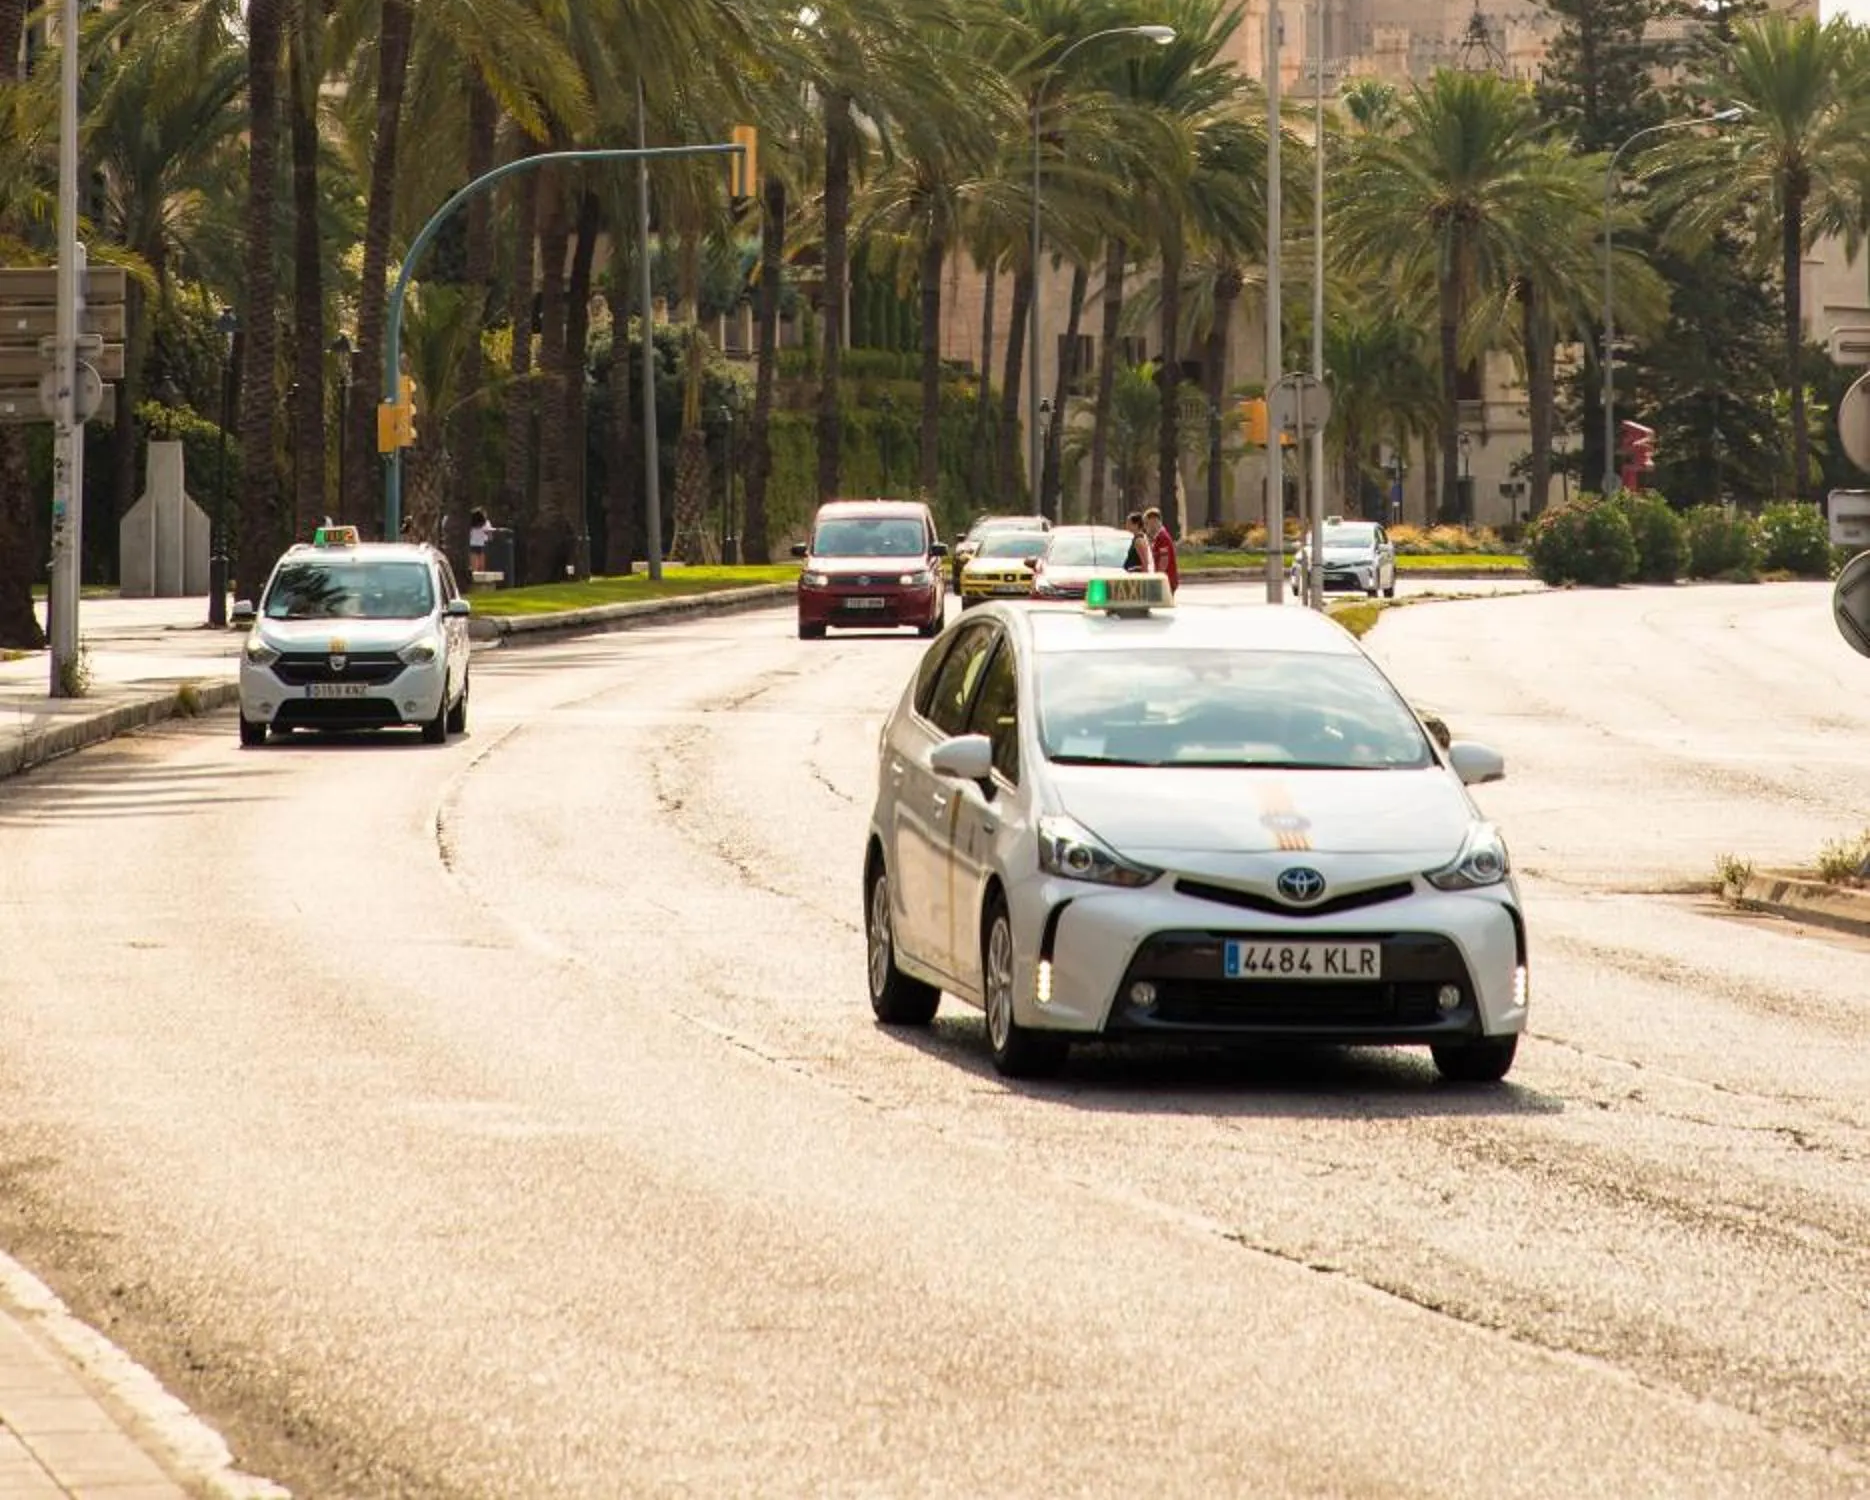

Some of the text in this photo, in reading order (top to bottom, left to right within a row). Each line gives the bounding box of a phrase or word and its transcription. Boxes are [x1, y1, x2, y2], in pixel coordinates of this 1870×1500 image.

[1109, 579, 1146, 601] TAXI
[1244, 947, 1375, 973] 4484 KLR
